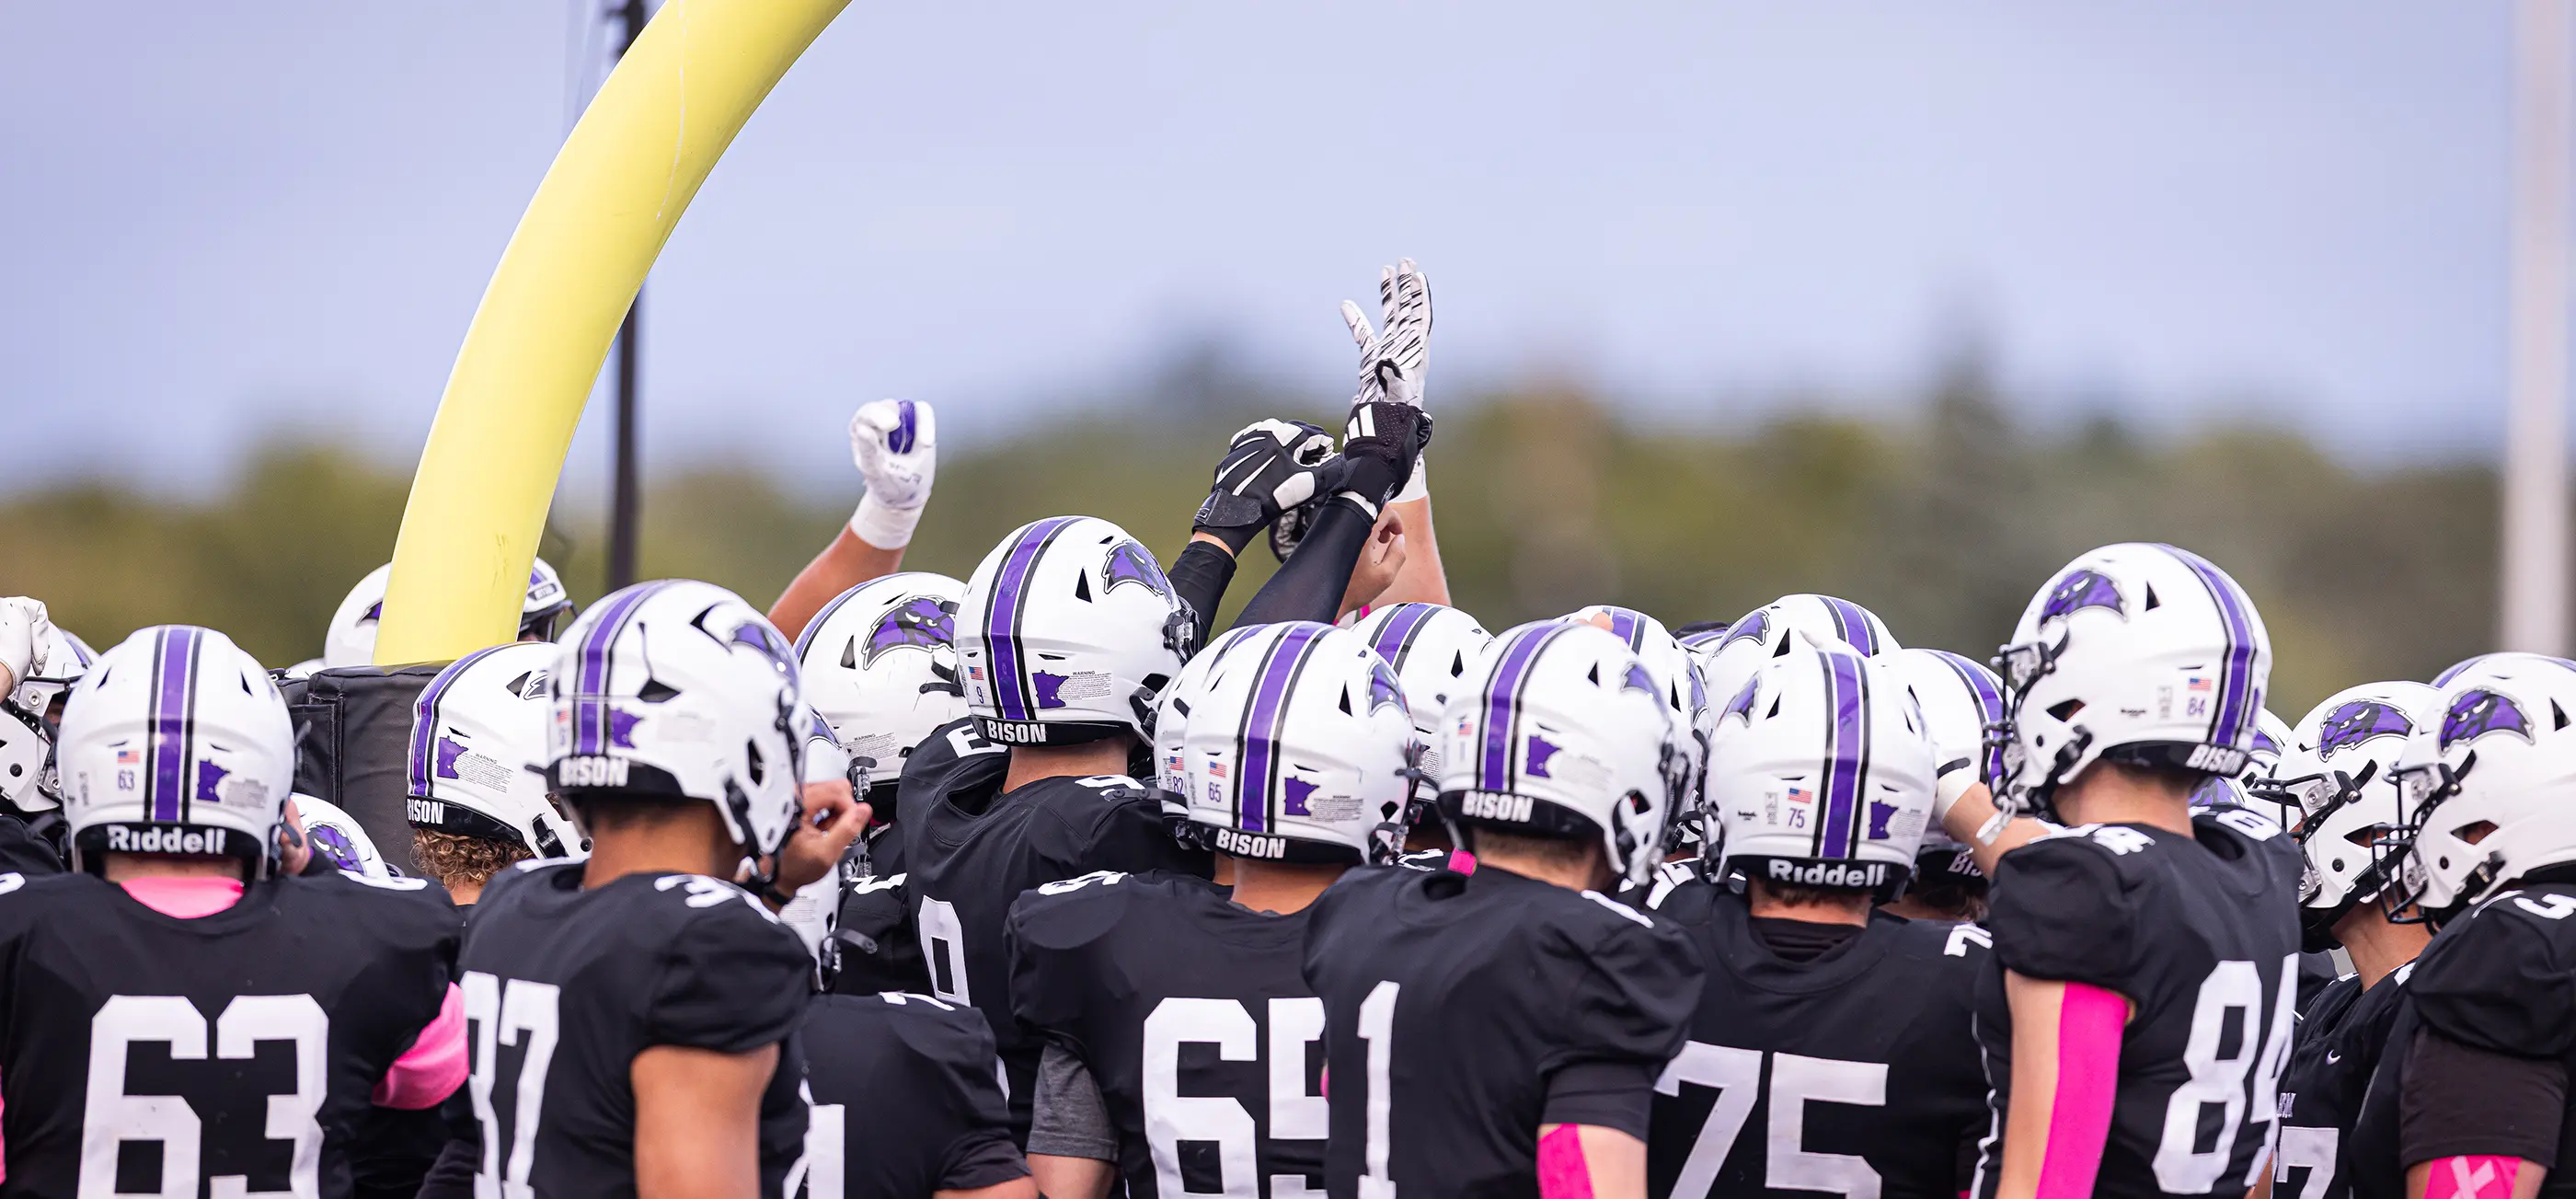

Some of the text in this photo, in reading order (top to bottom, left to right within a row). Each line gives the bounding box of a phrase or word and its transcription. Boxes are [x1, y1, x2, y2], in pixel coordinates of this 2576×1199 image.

[976, 686, 984, 704] 9
[2187, 697, 2206, 717] 84
[986, 720, 1047, 744] BISON
[118, 769, 135, 791] 63
[558, 755, 629, 787] BISON
[1172, 776, 1184, 795] 82
[1208, 781, 1222, 802] 65
[407, 798, 444, 824] BISON
[1461, 790, 1535, 823] BISON
[1788, 807, 1806, 829] 75
[107, 824, 227, 854] Riddell
[1215, 827, 1287, 859] BISON
[1768, 859, 1886, 887] Riddell
[77, 993, 329, 1199] 63
[1357, 980, 1401, 1199] 1
[1653, 1041, 1890, 1199] 75
